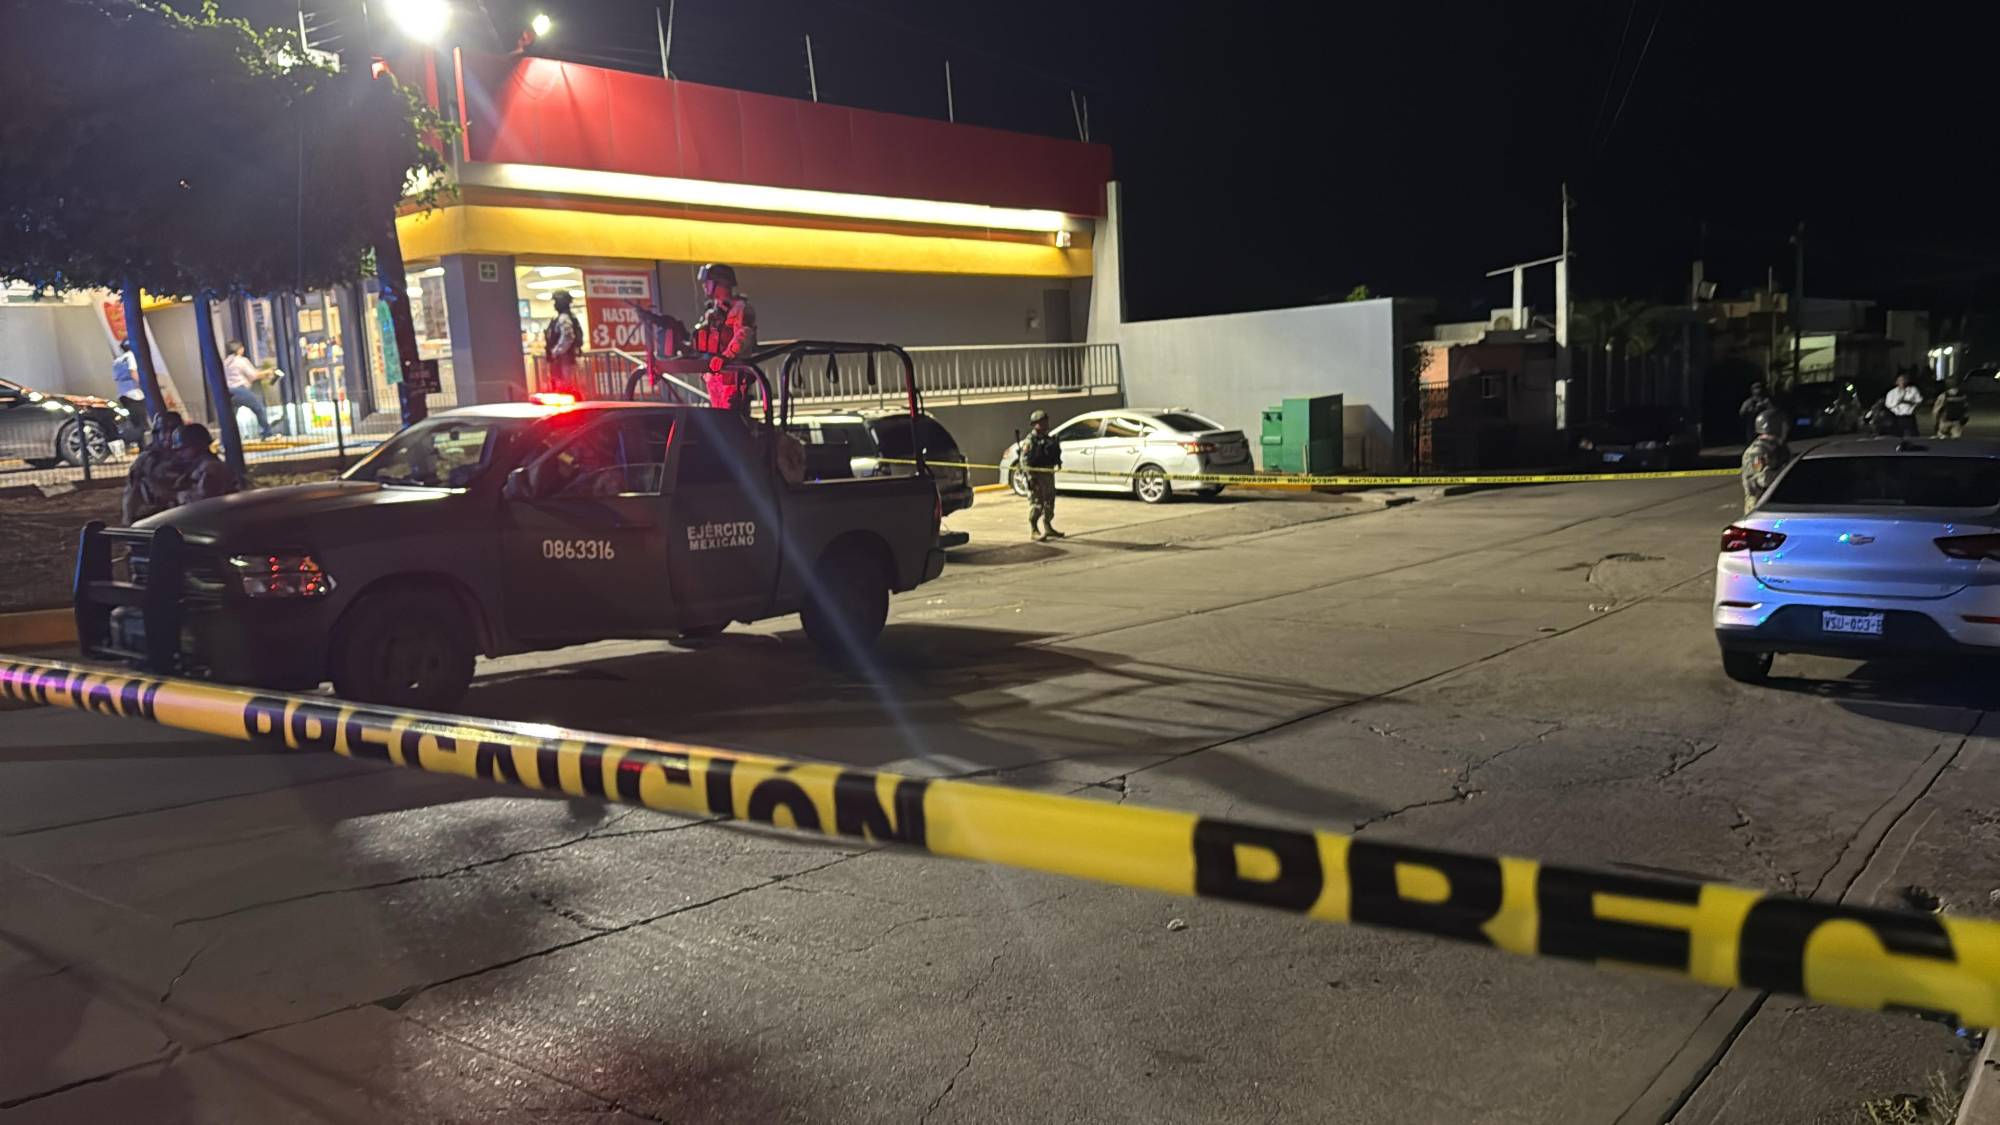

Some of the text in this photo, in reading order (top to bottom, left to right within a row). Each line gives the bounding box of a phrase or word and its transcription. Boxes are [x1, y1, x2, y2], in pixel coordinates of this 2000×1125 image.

[602, 307, 640, 323] HASTA
[687, 521, 756, 540] EJÉRCITO
[542, 540, 615, 560] 0863316
[688, 535, 755, 551] MEXICANO
